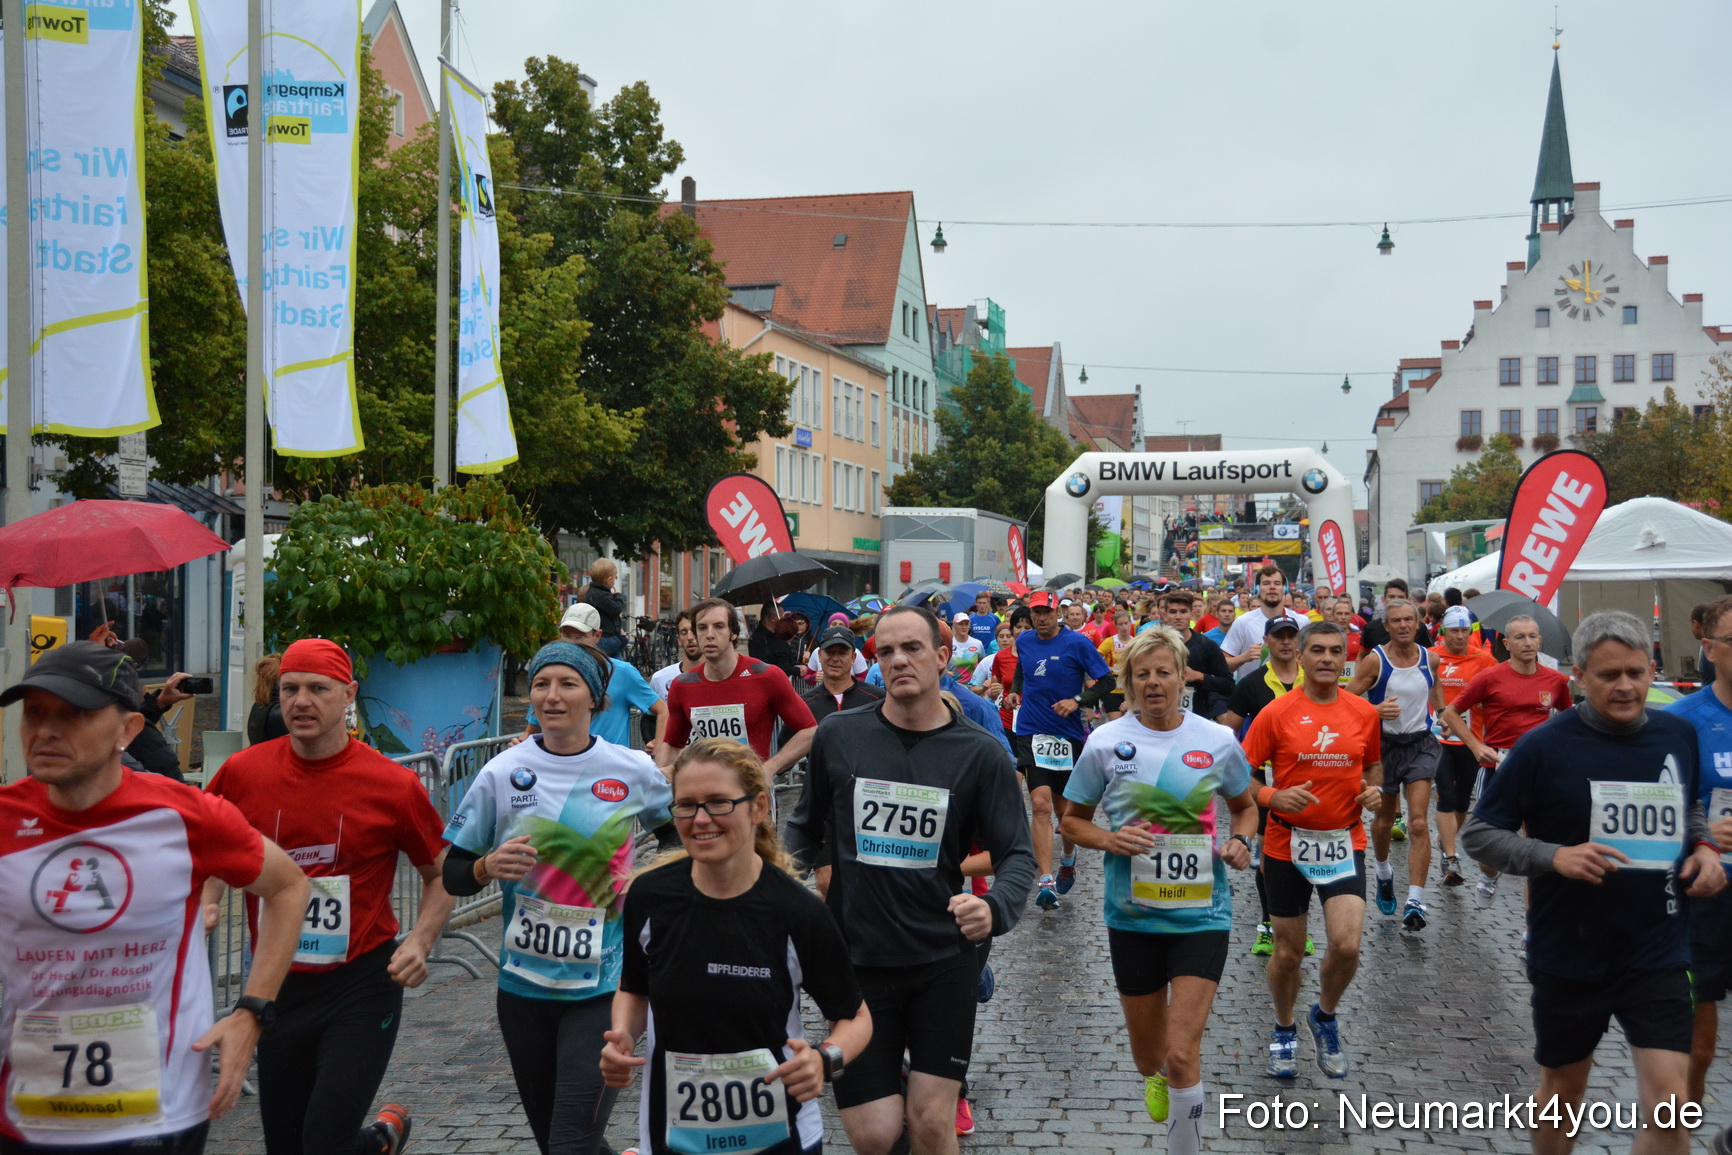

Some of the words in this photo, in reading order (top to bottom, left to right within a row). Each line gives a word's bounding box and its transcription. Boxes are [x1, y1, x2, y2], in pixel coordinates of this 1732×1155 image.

[1099, 461, 1166, 481] BMW
[1172, 459, 1292, 484] Laufsport
[1508, 471, 1592, 602] REWE
[1239, 543, 1262, 552] ZIEL
[713, 706, 740, 714] BOCK
[697, 717, 742, 738] 3046
[1037, 742, 1069, 756] 2786
[1297, 752, 1348, 761] funrunners
[1312, 759, 1353, 767] neumarkt
[862, 788, 890, 796] NeuerMarkt
[896, 786, 941, 800] BOCK
[1632, 785, 1676, 797] BOCK
[511, 794, 538, 803] PARTL
[861, 800, 938, 838] 2756
[1602, 803, 1676, 836] 3009
[862, 839, 930, 858] Christopher
[1170, 836, 1206, 847] BOCK
[295, 851, 320, 861] DEHN
[1297, 840, 1348, 862] 2145
[1150, 852, 1198, 880] 198
[1310, 867, 1337, 876] Robert
[1159, 887, 1187, 898] Heidi
[549, 907, 596, 920] BOCK
[515, 917, 593, 960] 3008
[17, 947, 75, 962] LAUFEN
[84, 948, 115, 963] MIT
[125, 939, 168, 958] HERZ
[32, 971, 46, 980] Dr.
[51, 972, 78, 981] Heck
[90, 967, 107, 977] Dr.
[718, 964, 771, 978] PFLEIDERER
[71, 1009, 144, 1031] BOCK
[53, 1041, 113, 1088] 78
[711, 1053, 768, 1071] BOCK
[50, 1099, 124, 1113] Michael
[678, 1077, 775, 1122] 2806
[707, 1134, 747, 1150] Irene
